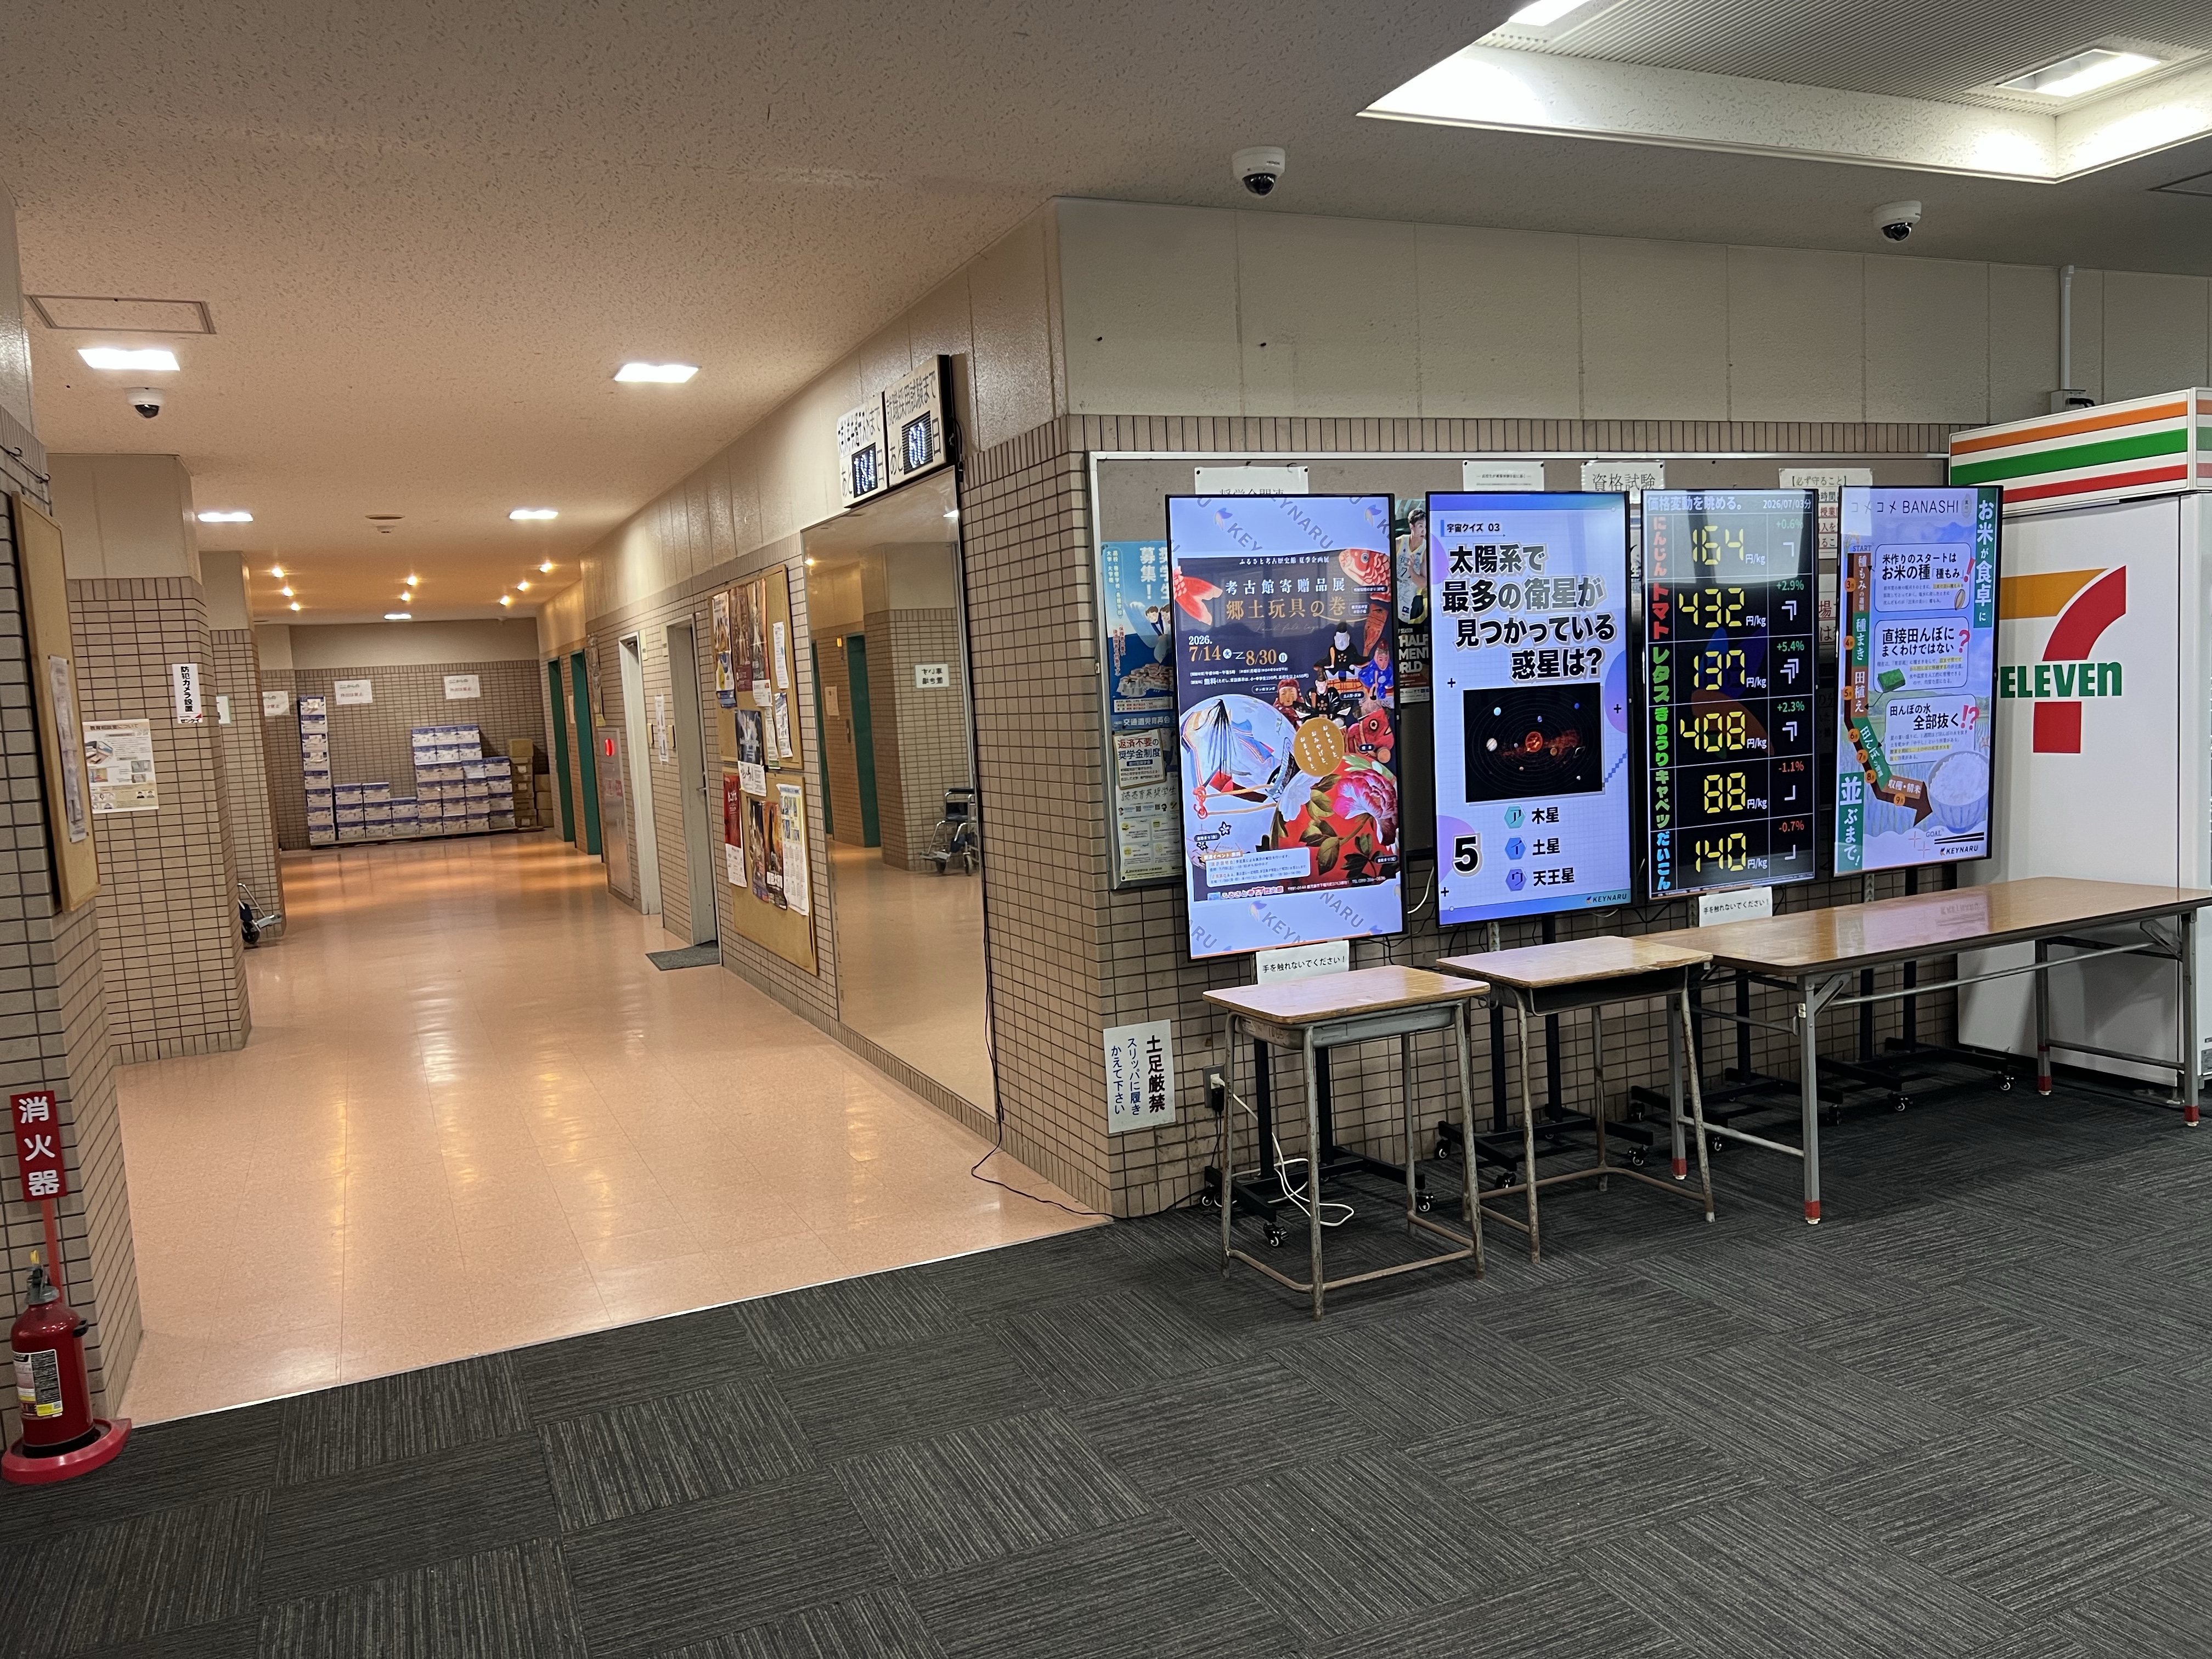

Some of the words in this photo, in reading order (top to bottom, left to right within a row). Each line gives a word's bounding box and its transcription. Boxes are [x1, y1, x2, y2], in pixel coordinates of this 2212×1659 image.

[890, 439, 904, 476] あと
[908, 422, 926, 469] 60
[932, 417, 941, 456] 日
[842, 464, 853, 498] あと
[877, 448, 884, 482] 日
[1592, 473, 1656, 491] 資格試験
[1792, 475, 1847, 487] 【必ず守ること】
[1647, 496, 1742, 511] 価格変動を眺める。
[1763, 499, 1812, 510] 2026/07/03分
[1851, 501, 1897, 514] コメコメ
[1903, 500, 1959, 514] BANASHI
[1447, 523, 1483, 533] 宇宙クイズ
[1488, 523, 1500, 532] 03
[1776, 519, 1804, 529] +0.6%
[1654, 516, 1667, 577] にんじん
[1692, 525, 1744, 565] 164
[1745, 554, 1765, 565] 円/kg
[1449, 544, 1545, 574] 太陽系で
[1882, 553, 1956, 565] 米作りのスタートは
[1975, 499, 1994, 622] お米が食卓に
[1139, 547, 1156, 600] 募集！
[1225, 577, 1346, 596] 考古館寄贈品展
[1776, 579, 1804, 591] +2.9%
[1225, 596, 1347, 620] 郷土玩具の巻
[1443, 577, 1604, 613] 最多の衛星が
[1679, 588, 1745, 628] 432
[1746, 615, 1767, 628] 円/kg
[1652, 582, 1669, 640] トマト
[1188, 635, 1213, 645] 2026.
[1455, 613, 1615, 647] 見つかっている
[1856, 618, 1866, 661] 種まき
[1882, 626, 1954, 645] 直接田んぼに
[1189, 645, 1221, 662] 7/14
[1245, 649, 1277, 665] 8/30
[1776, 640, 1805, 652] +5.4%
[1882, 644, 1954, 658] まくわけではない
[1511, 647, 1602, 680] 惑星は？
[1652, 646, 1670, 703] レタス
[1694, 650, 1745, 690] 137
[1746, 677, 1767, 688] 円/kg
[180, 665, 194, 712] 防犯カメラ設置
[1854, 670, 1866, 713] 田植え
[1777, 702, 1805, 713] +2.3%
[1889, 703, 1931, 716] 田んぼの水
[1680, 711, 1746, 753] 408
[1747, 738, 1767, 750] 円/kg
[1913, 713, 1959, 731] 全部抜く
[1118, 737, 1159, 749] 返済不要の
[1655, 707, 1669, 767] きゅうり
[1118, 748, 1161, 760] 奨学金制度
[1779, 761, 1804, 773] -1.1%
[1655, 770, 1670, 828] キャベツ
[1704, 772, 1746, 814] 88
[1747, 799, 1767, 810] 円/kg
[1510, 809, 1522, 825] ア
[1531, 806, 1560, 824] 木星
[1779, 821, 1805, 833] -0.7%
[1453, 834, 1480, 873] 5
[1511, 839, 1522, 855] イ
[1532, 838, 1560, 856] 土星
[1695, 832, 1746, 873] 140
[1747, 859, 1768, 870] 円/kg
[1946, 844, 1979, 855] KEYNARU
[1657, 832, 1671, 891] だいこん
[1511, 871, 1524, 887] ウ
[1533, 867, 1575, 887] 天王星
[1222, 885, 1284, 899] ふるさと考古歴史館
[1593, 893, 1628, 903] KEYNARU
[1111, 1045, 1125, 1115] かえて下さい
[1127, 1037, 1141, 1115] スリッパに履き
[1146, 1035, 1166, 1114] 土足厳禁
[18, 1096, 61, 1197] 消火器
